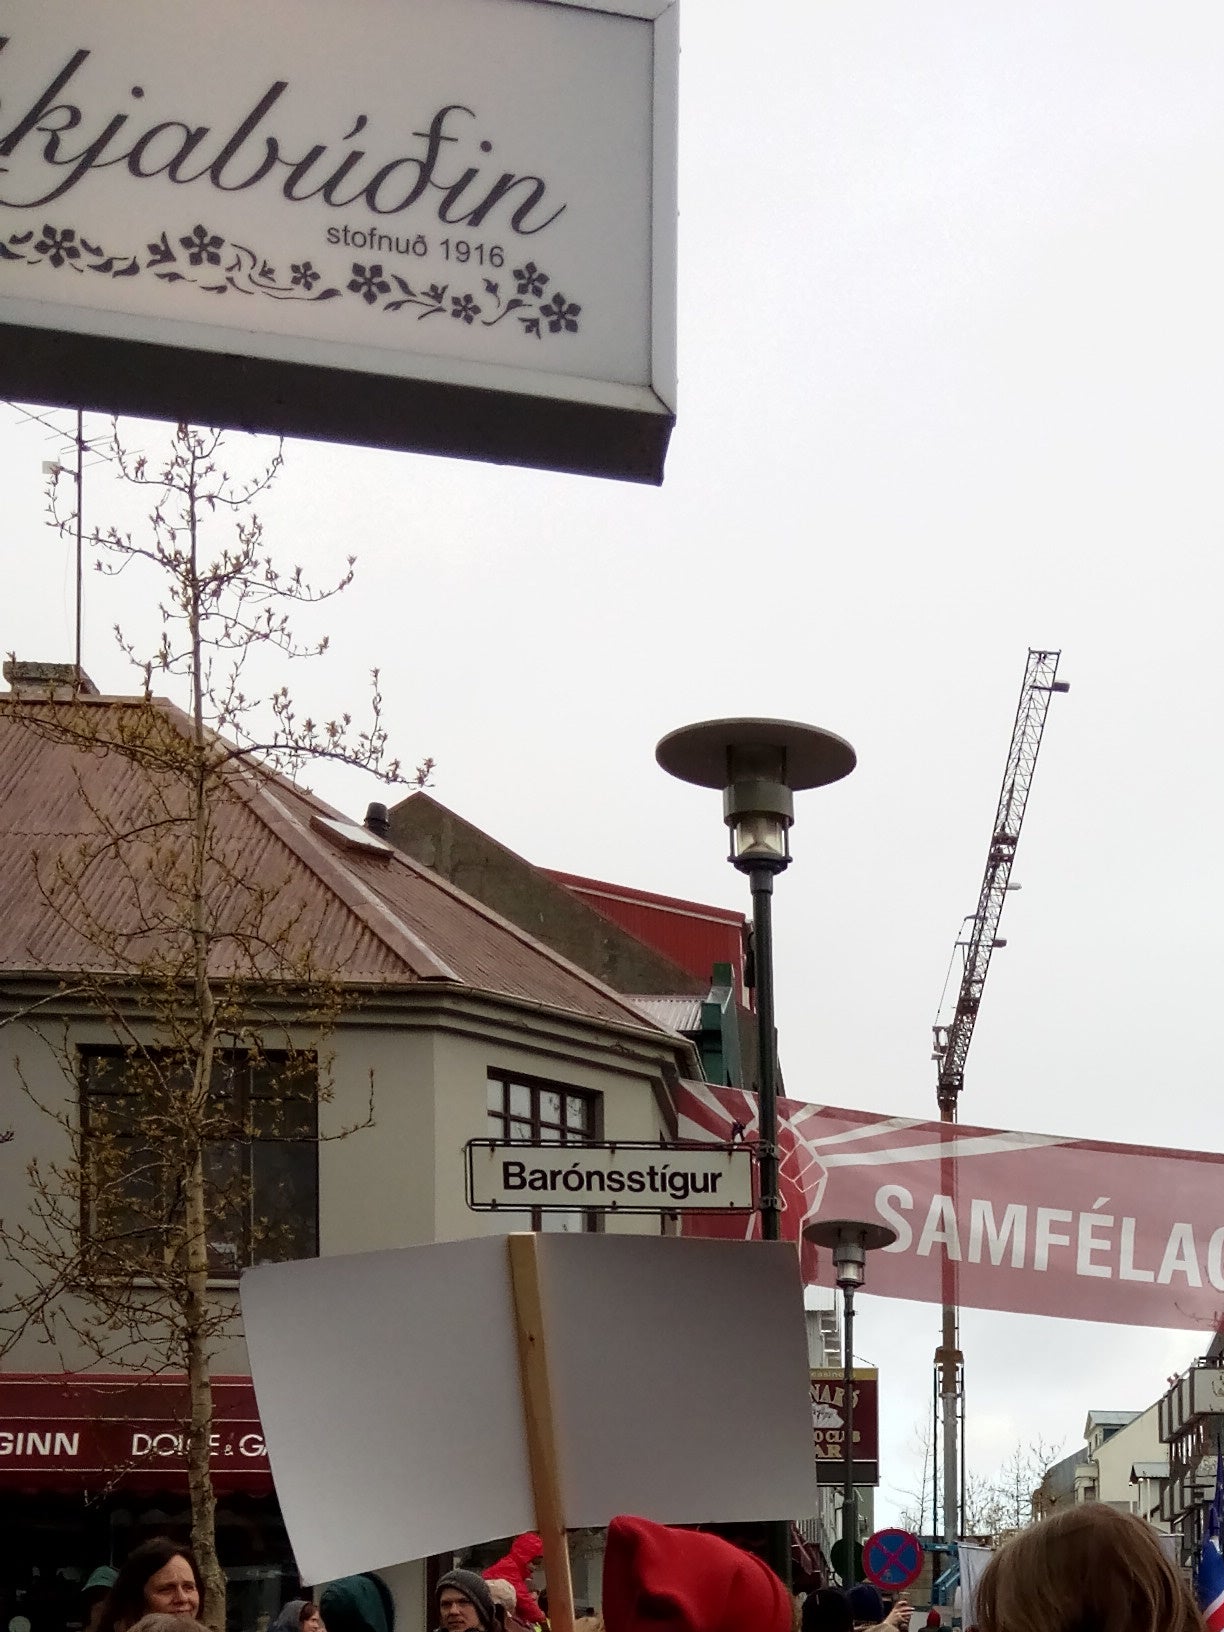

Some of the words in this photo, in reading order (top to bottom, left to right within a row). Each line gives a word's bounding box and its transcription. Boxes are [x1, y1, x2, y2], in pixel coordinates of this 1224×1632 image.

[0, 37, 567, 235] kjabúðin
[326, 224, 428, 257] stofnuð
[439, 237, 506, 268] 1916
[502, 1160, 722, 1200] Barónsstígur
[131, 1433, 222, 1457] DOLE
[238, 1433, 268, 1457] G
[814, 1444, 842, 1458] AR
[825, 1430, 861, 1443] CLB
